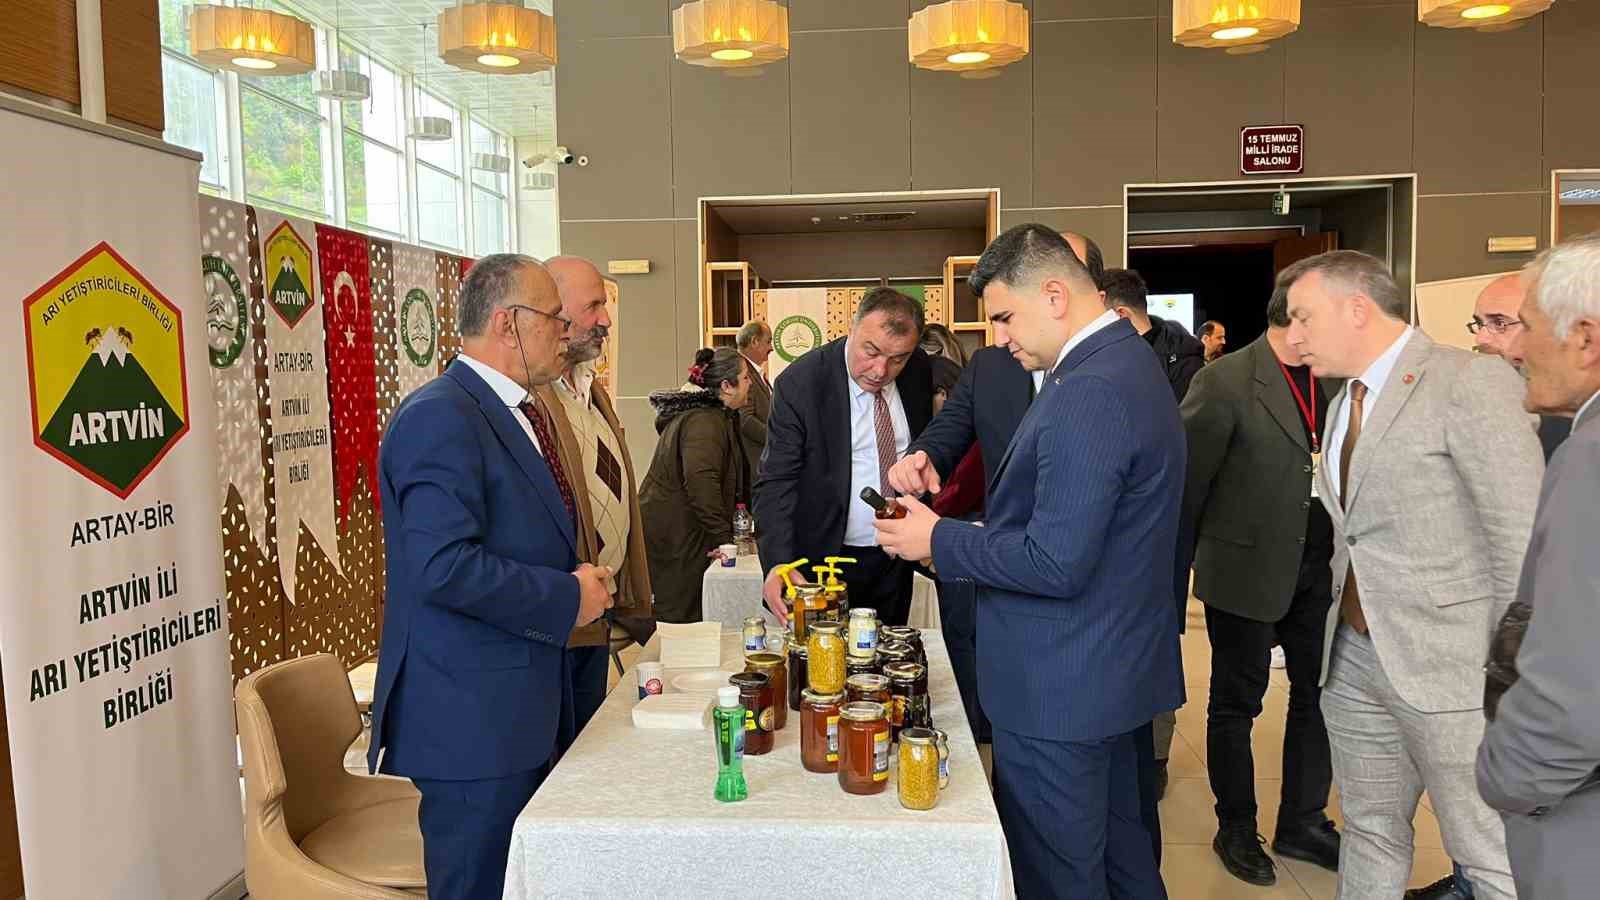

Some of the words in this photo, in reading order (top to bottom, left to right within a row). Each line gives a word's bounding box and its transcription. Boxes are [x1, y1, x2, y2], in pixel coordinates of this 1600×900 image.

[1246, 144, 1269, 155] MİLLİ
[1271, 143, 1299, 154] İRADE
[1247, 135, 1258, 144] 15
[1260, 133, 1298, 143] TEMMUZ
[1253, 156, 1291, 166] SALONU
[42, 303, 60, 326] ARI
[58, 275, 141, 306] YETİŞTİRİCİLERİ
[141, 295, 173, 333] BİRLİĞİ
[275, 288, 305, 306] ARTVİN
[274, 349, 313, 373] ARTAY-BİR
[69, 402, 165, 447] ARTVİN
[70, 500, 175, 547] ARTAY-BİR
[79, 573, 151, 624] ARTVİN
[157, 562, 178, 600] İLİ
[29, 659, 67, 702] ARI
[73, 599, 222, 684] YETİŞTİRİCİLERİ
[103, 667, 173, 729] BİRLİĞİ
